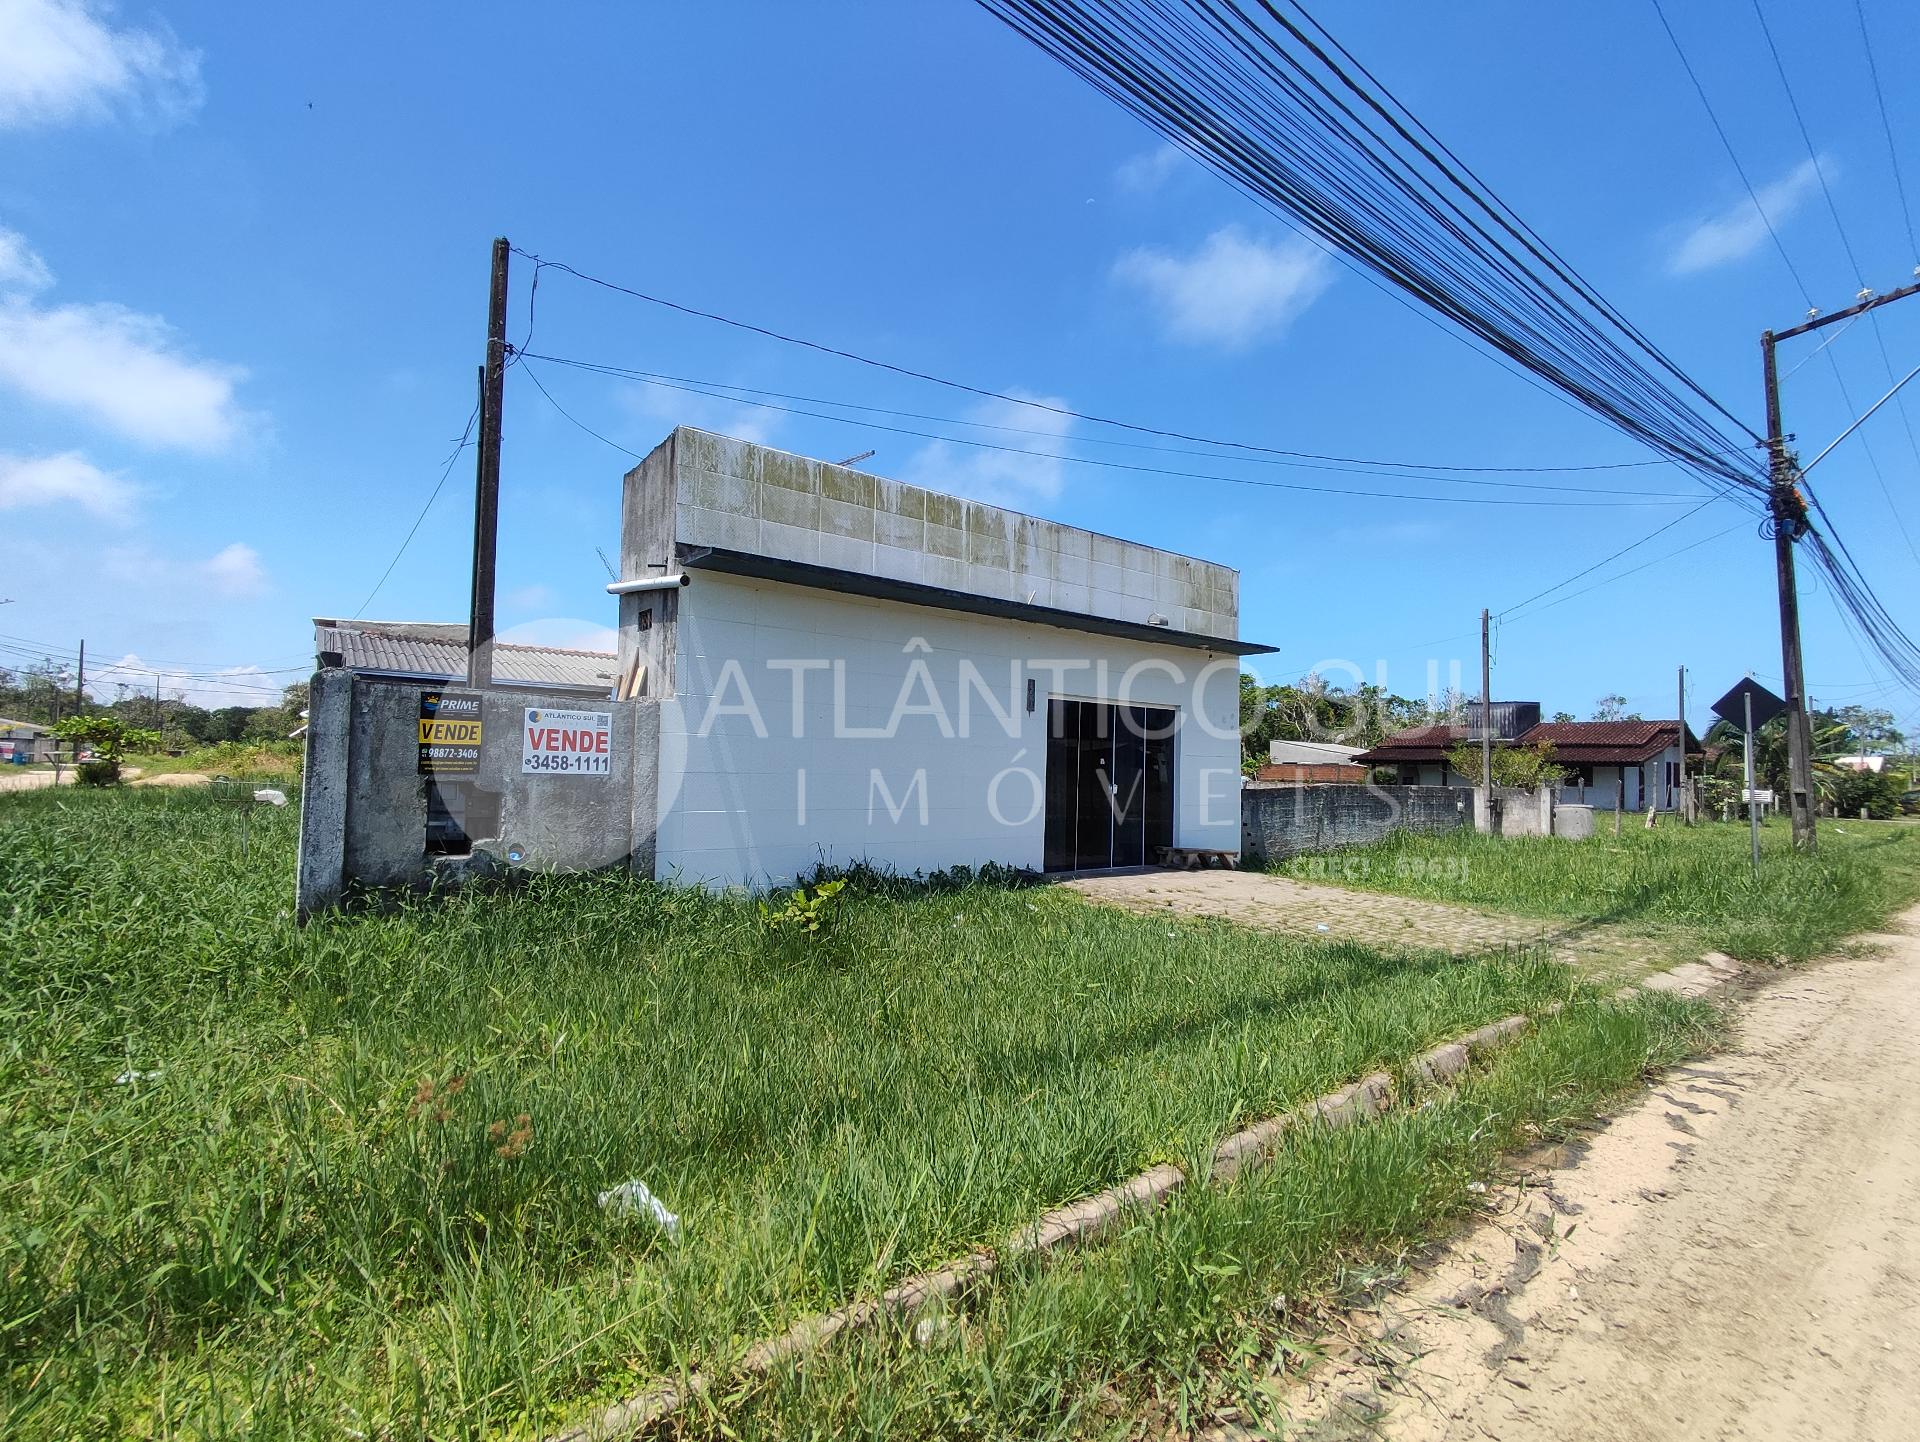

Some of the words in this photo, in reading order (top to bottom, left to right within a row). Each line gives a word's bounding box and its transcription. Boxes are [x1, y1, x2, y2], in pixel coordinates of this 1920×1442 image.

[440, 699, 480, 711] PRIME
[544, 712, 582, 721] ATLÂNTICO
[422, 723, 480, 741] VENDE
[528, 727, 609, 753] VENDE
[428, 748, 478, 758] 98872-3406
[531, 754, 609, 771] 3458-1111
